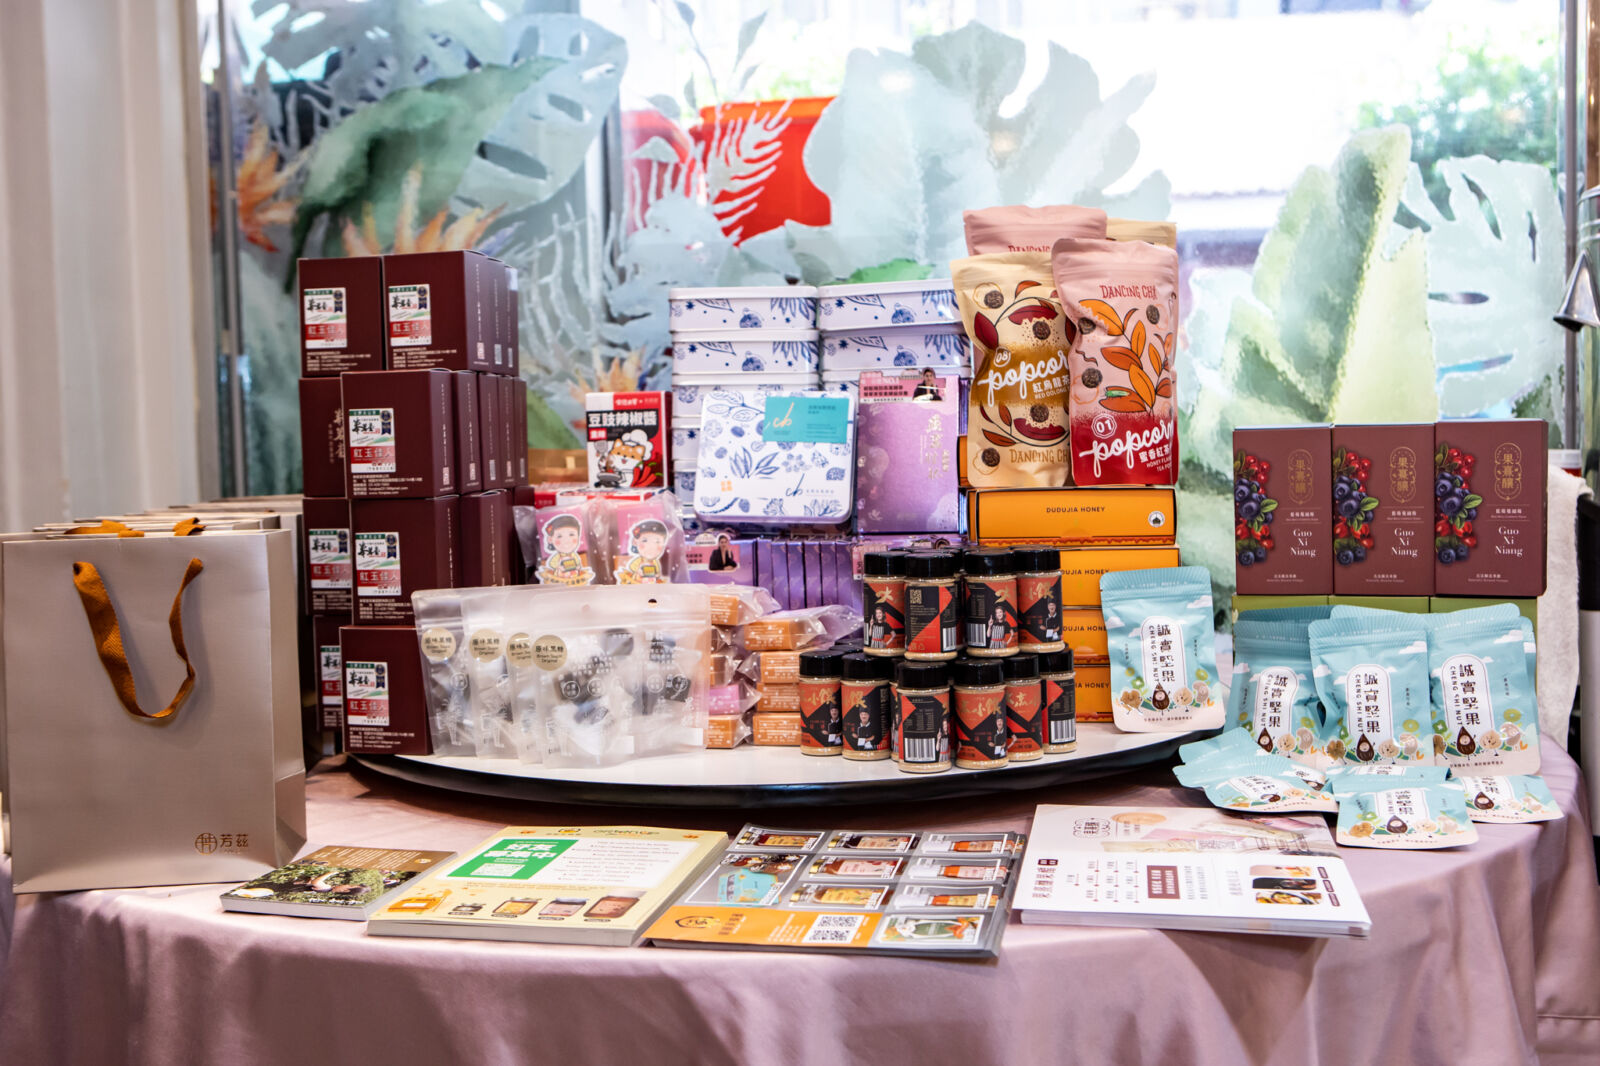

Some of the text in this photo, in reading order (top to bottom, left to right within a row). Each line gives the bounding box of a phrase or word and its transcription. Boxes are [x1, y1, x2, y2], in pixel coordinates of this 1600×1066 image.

[1100, 285, 1141, 300] DANCING
[977, 350, 1069, 407] popcor
[588, 411, 657, 428] 豆豉辣椒醬
[1097, 421, 1112, 433] 01
[353, 448, 395, 459] 紅玉佳人
[1079, 419, 1174, 478] popcorn
[1140, 444, 1171, 464] 蜜香紅茶
[1009, 449, 1068, 465] DANCING CH
[1293, 528, 1312, 537] Guo
[1394, 527, 1415, 536] Guo
[1499, 526, 1519, 535] Guo
[1400, 537, 1410, 546] Xi
[1503, 536, 1514, 545] Xi
[1290, 547, 1316, 557] Niang
[1391, 546, 1418, 558] Niang
[1495, 546, 1523, 557] Niang
[360, 571, 400, 582] 紅玉佳人
[1157, 624, 1175, 683] 誠實堅果
[1268, 674, 1289, 728] 誠實堅果
[1459, 664, 1480, 726] 誠實堅果
[350, 700, 387, 711] 紅玉佳人
[1363, 672, 1381, 733] 誠實堅果
[219, 833, 249, 848] 芳茲
